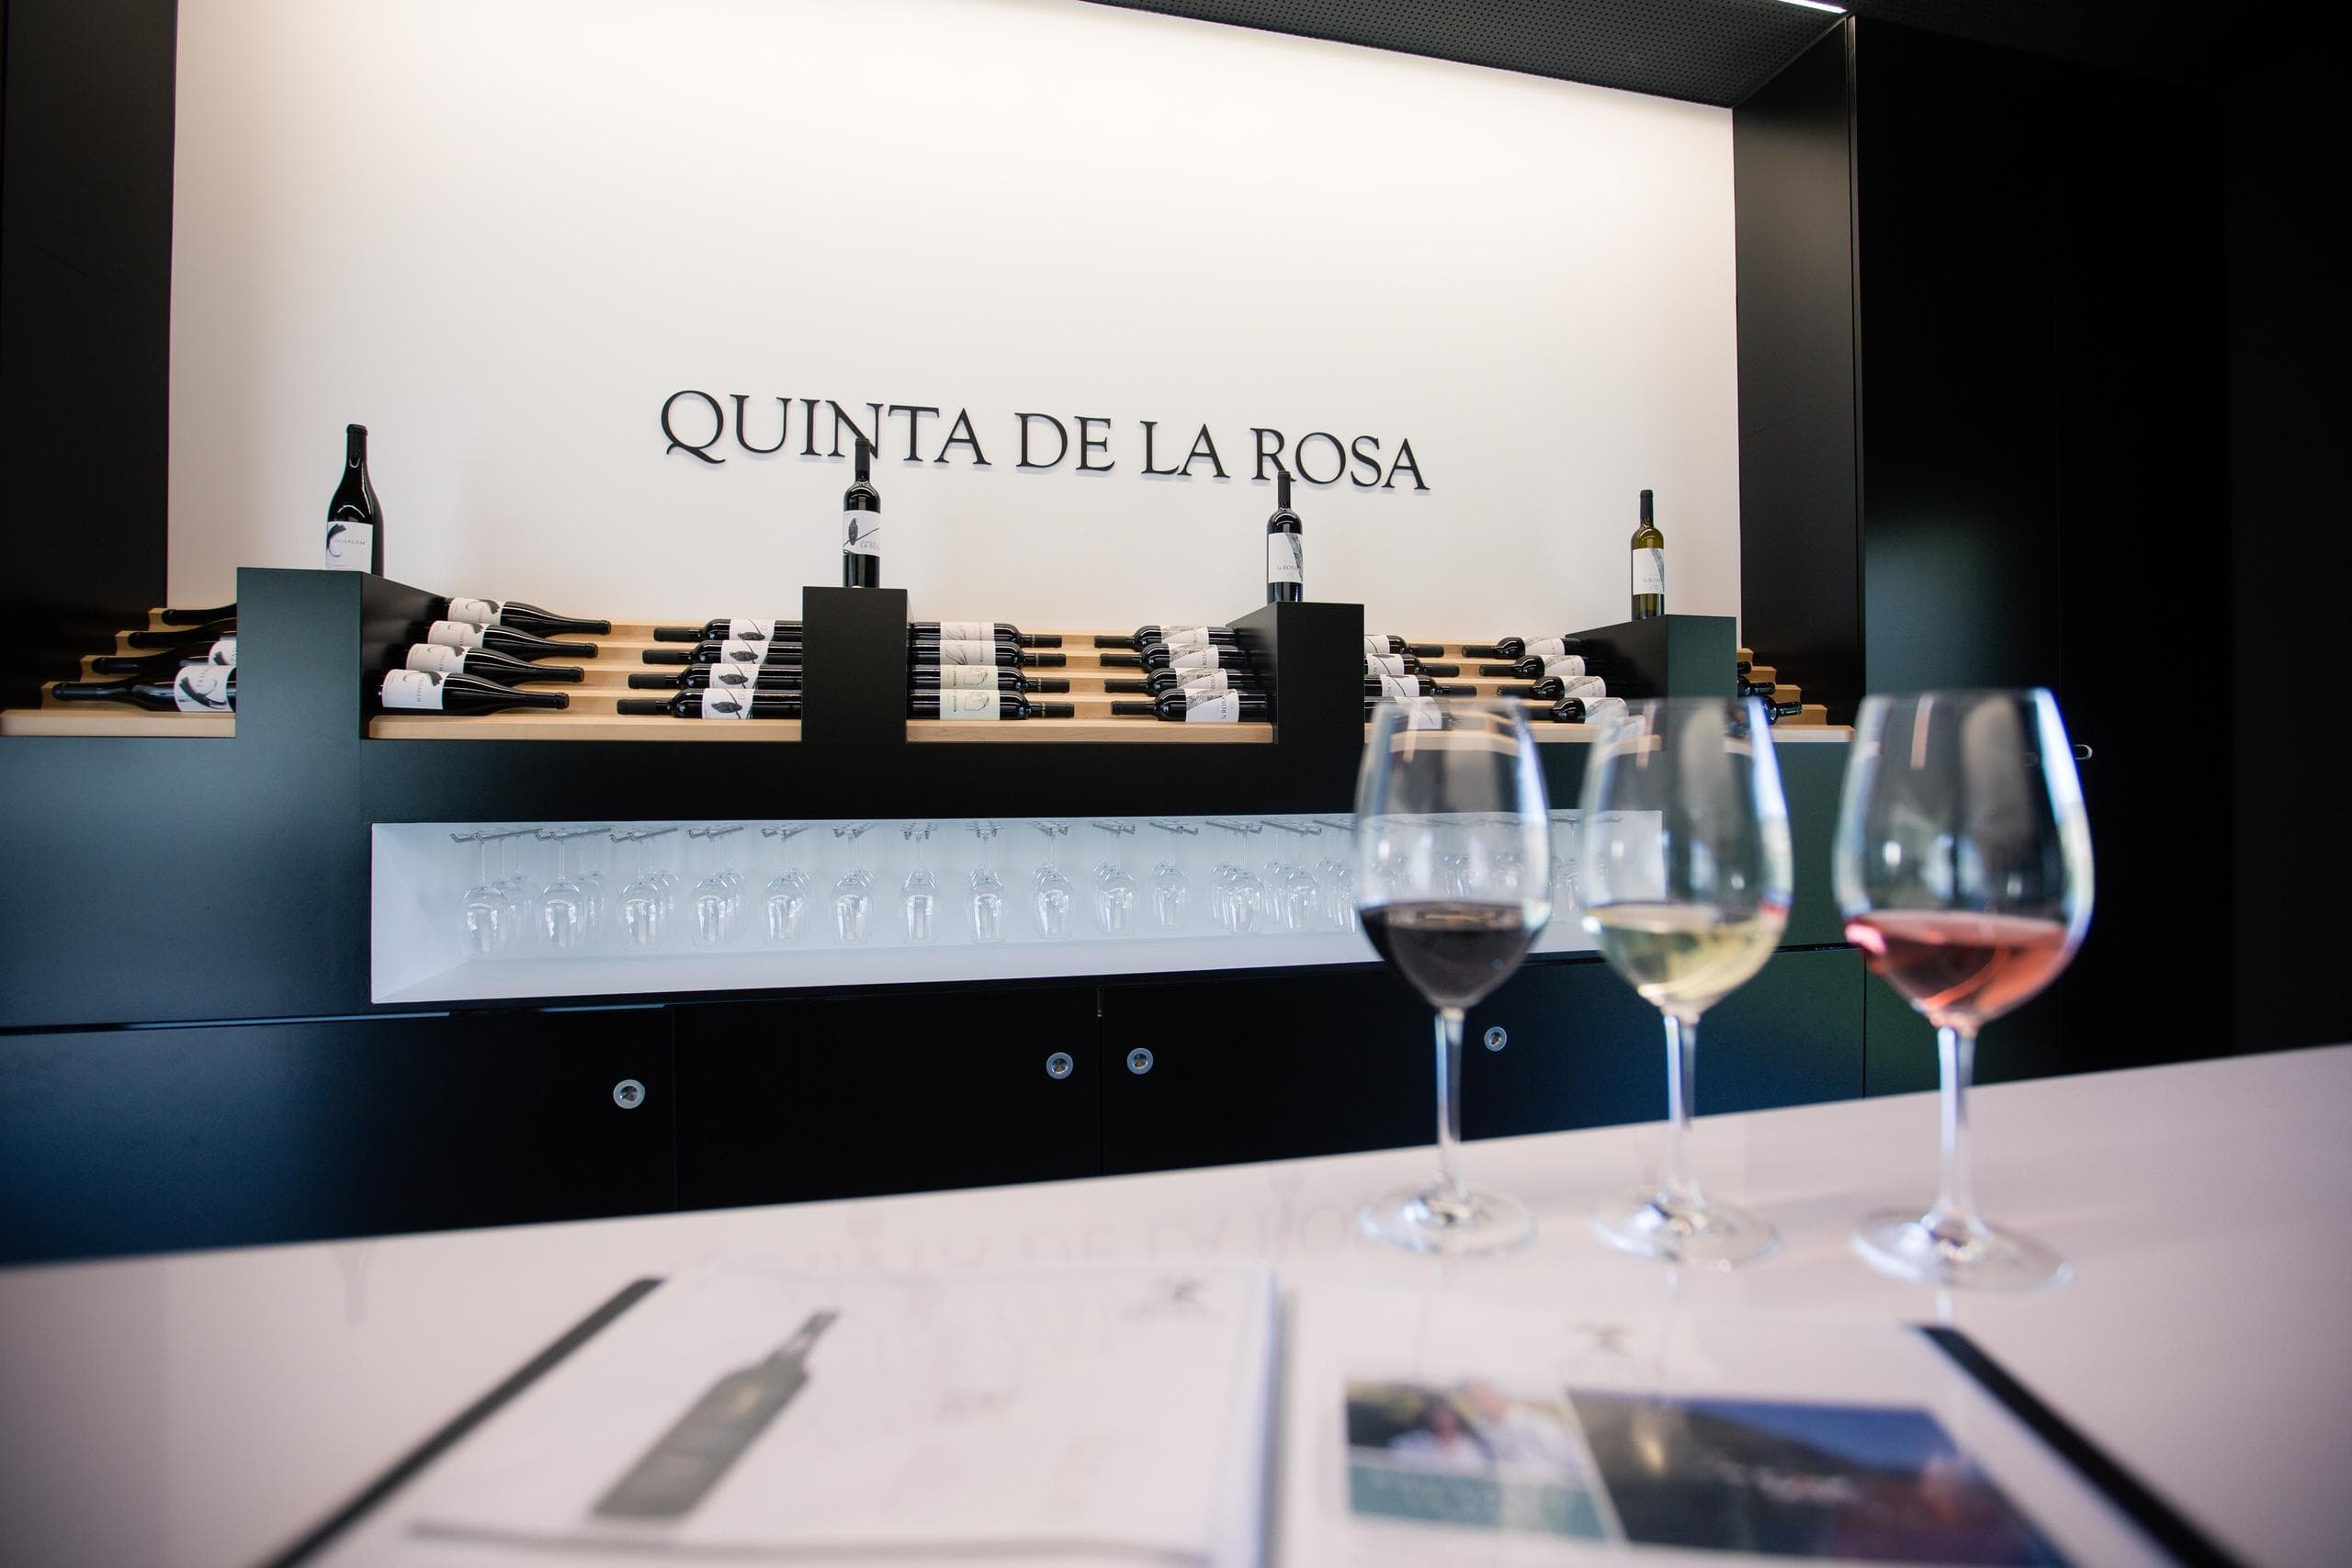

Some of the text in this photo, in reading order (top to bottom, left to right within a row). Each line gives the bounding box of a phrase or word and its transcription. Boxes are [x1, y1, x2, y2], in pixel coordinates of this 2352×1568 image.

[660, 389, 1431, 491] QUINTA DE LA ROSA
